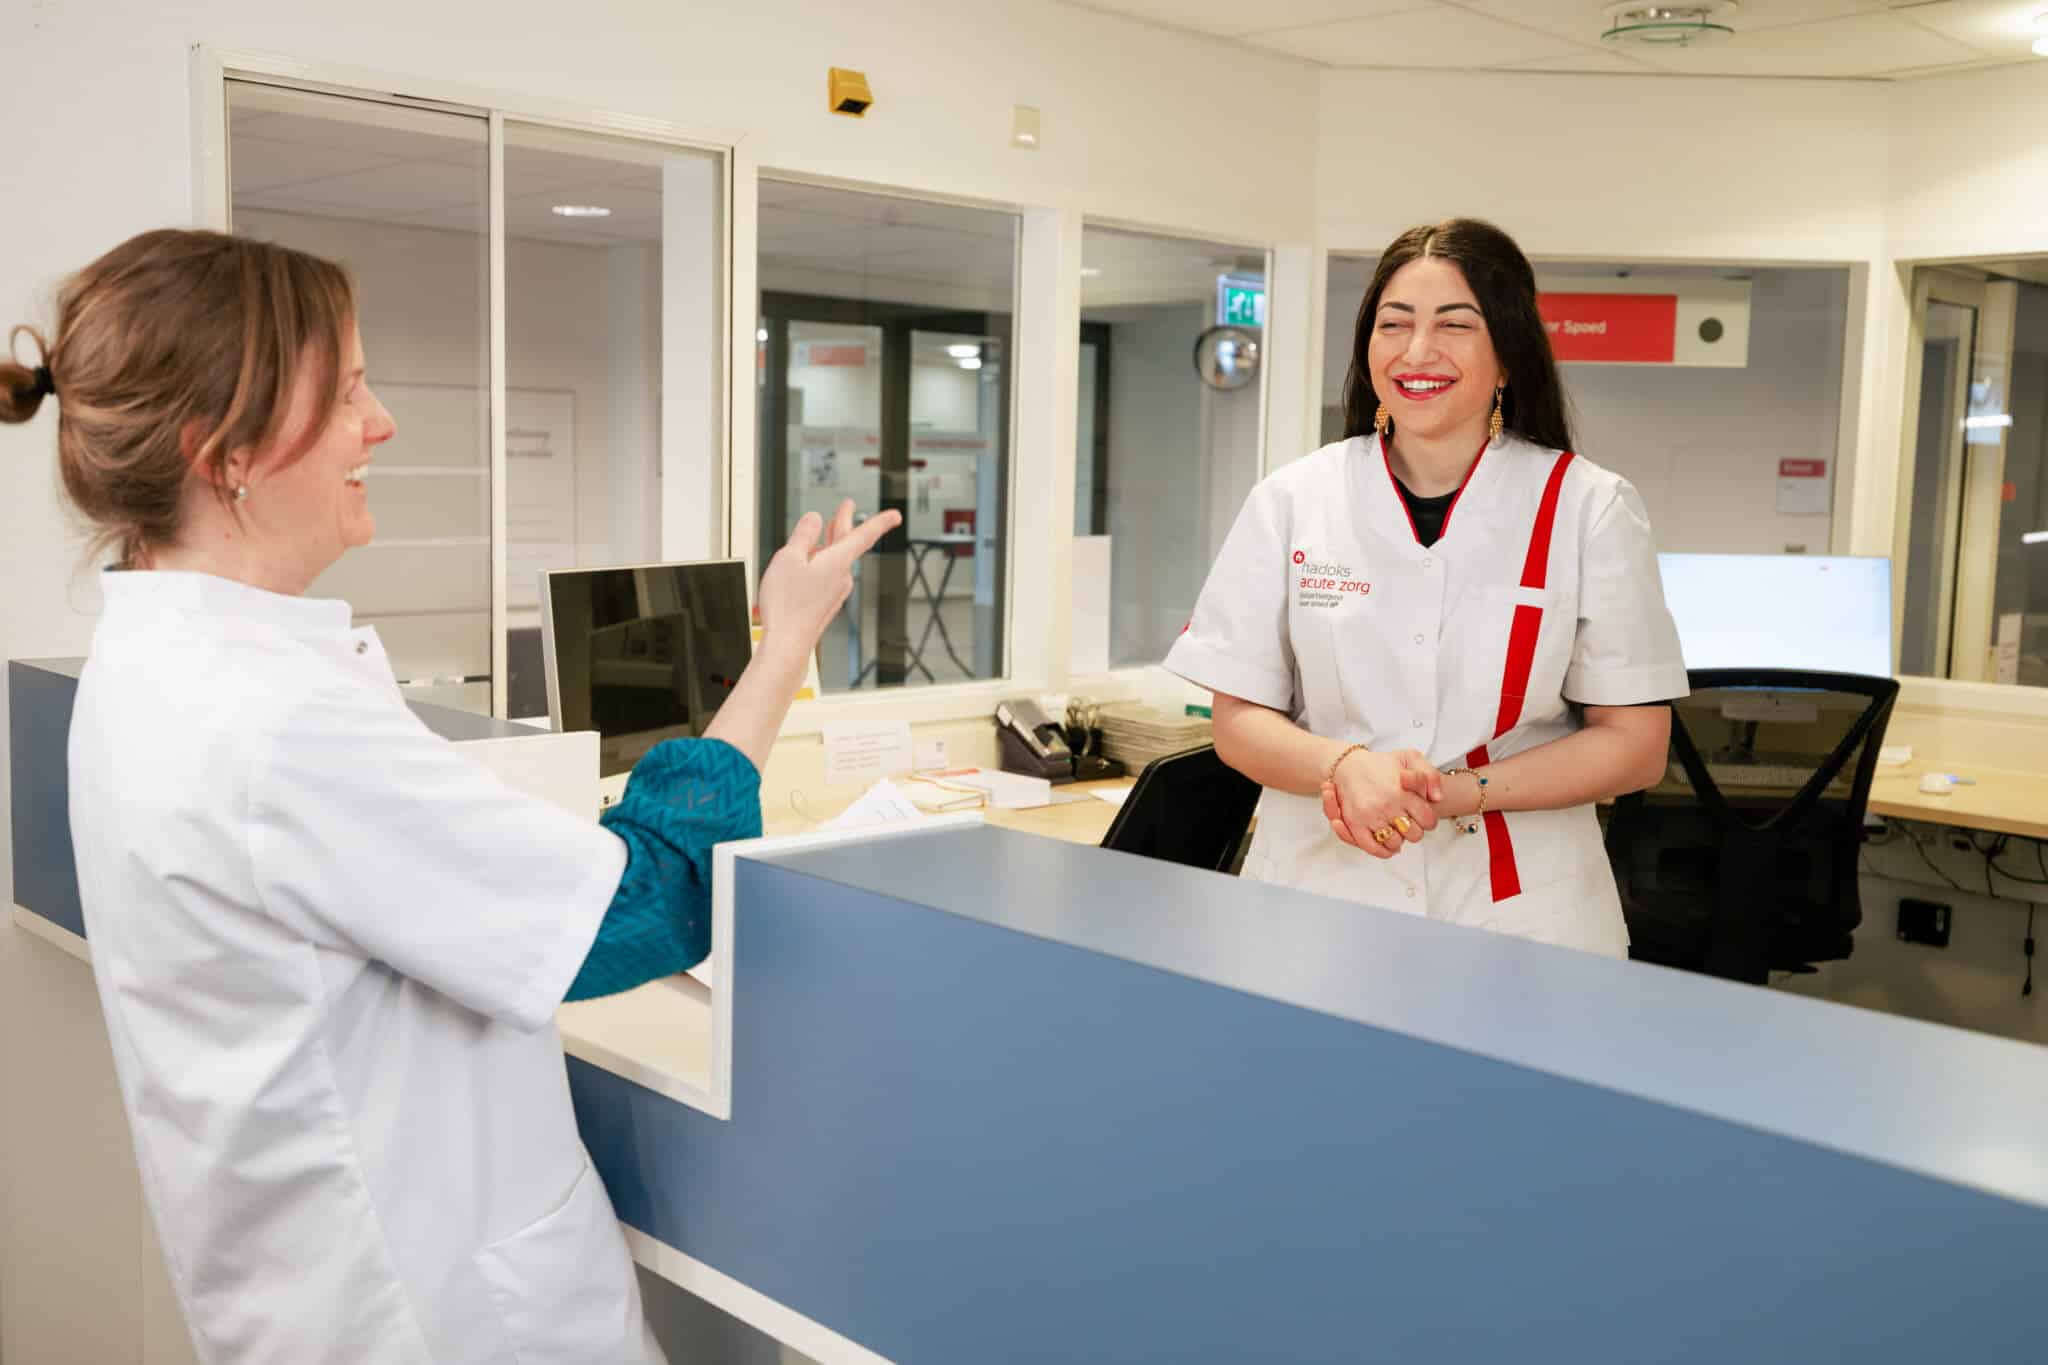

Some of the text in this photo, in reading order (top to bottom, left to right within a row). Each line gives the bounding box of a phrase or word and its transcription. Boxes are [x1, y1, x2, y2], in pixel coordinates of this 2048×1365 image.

[1564, 319, 1607, 336] Spoed
[1302, 561, 1352, 577] hadoks
[1300, 578, 1371, 595] acute zorg
